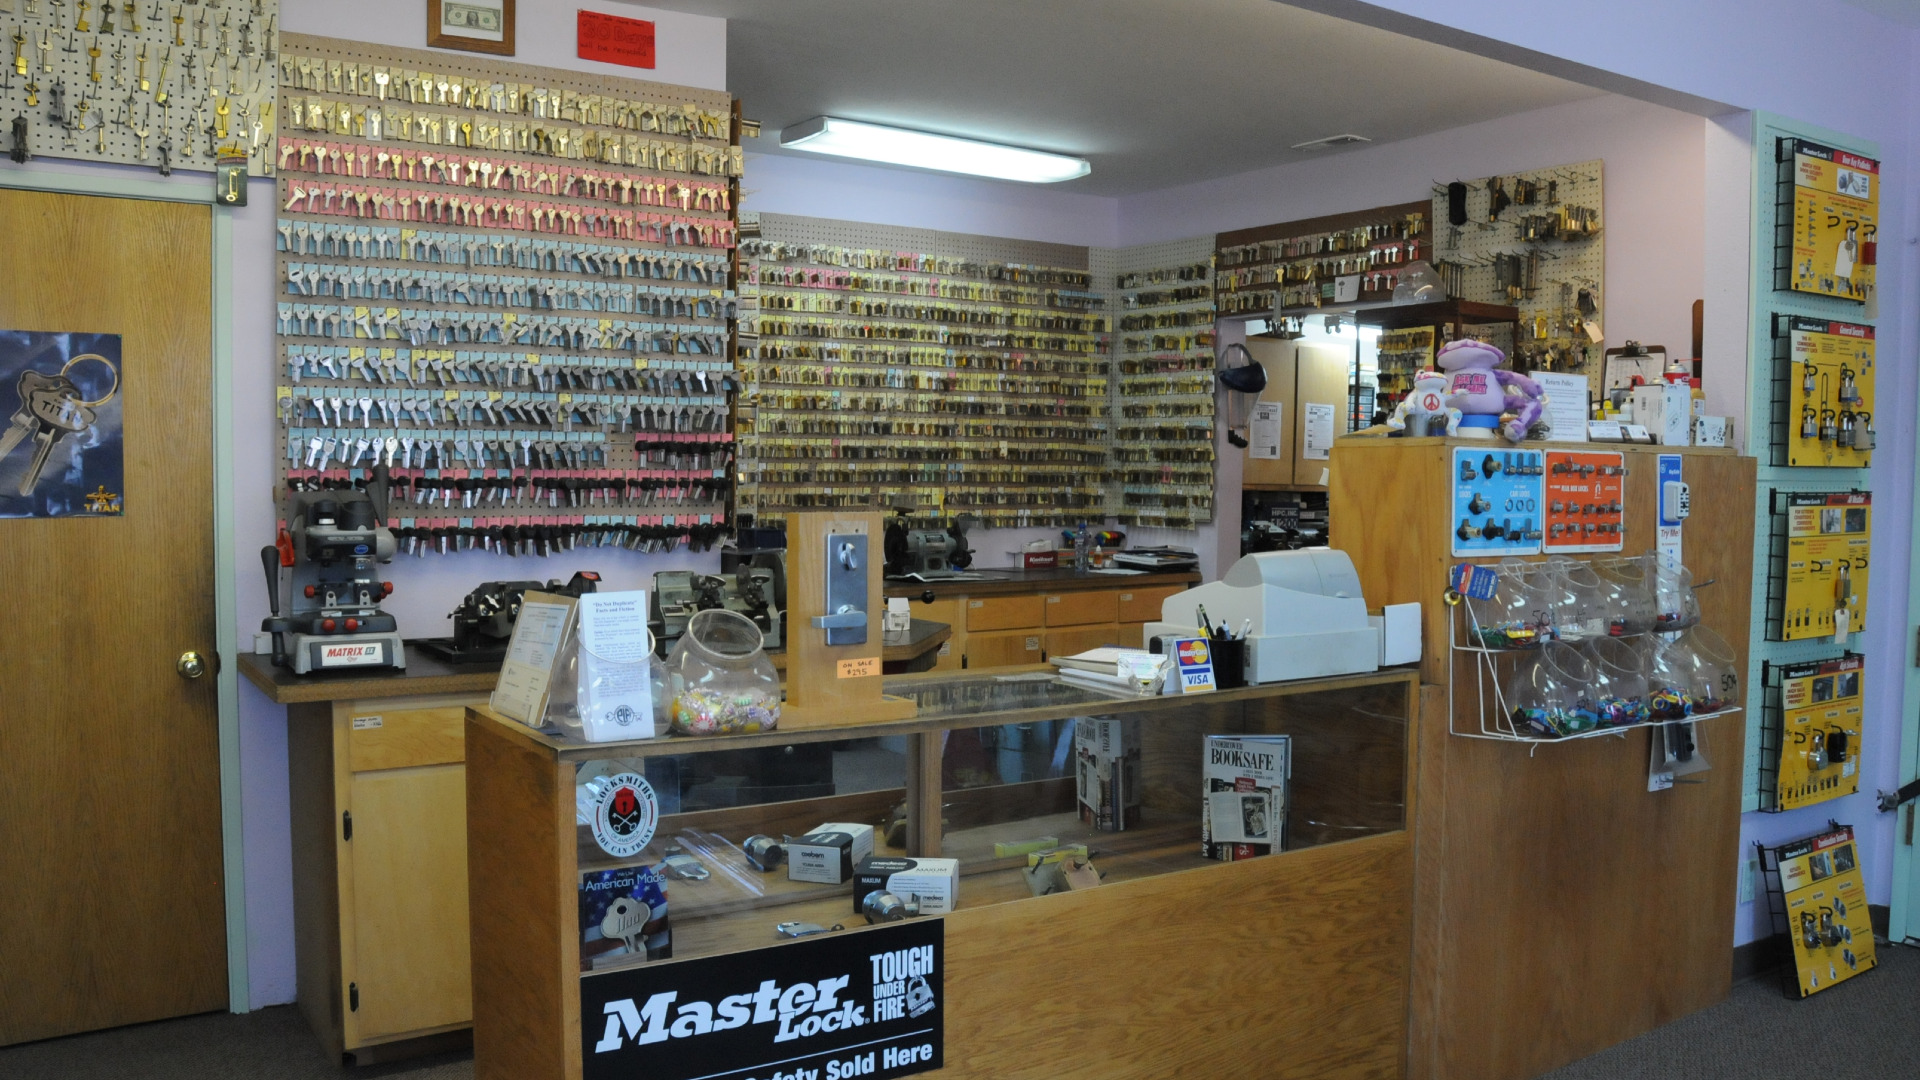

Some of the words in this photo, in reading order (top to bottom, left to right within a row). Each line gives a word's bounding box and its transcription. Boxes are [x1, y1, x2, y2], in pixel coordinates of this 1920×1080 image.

[84, 503, 120, 512] TITAN
[327, 646, 364, 657] MATRIX
[1187, 674, 1209, 684] VISA
[1211, 748, 1274, 771] BOOKSAFE
[596, 776, 653, 804] LOCKSMITHS
[597, 832, 610, 847] YOU
[611, 845, 627, 854] CAN
[631, 829, 653, 852] TRUST
[585, 877, 634, 892] American
[636, 871, 665, 885] Made
[869, 944, 934, 985] TOUGH
[873, 980, 905, 1000] UNDER
[595, 974, 850, 1054] Master
[873, 995, 906, 1023] FIRE
[826, 1051, 875, 1080] Sold
[883, 1043, 933, 1070] Here
